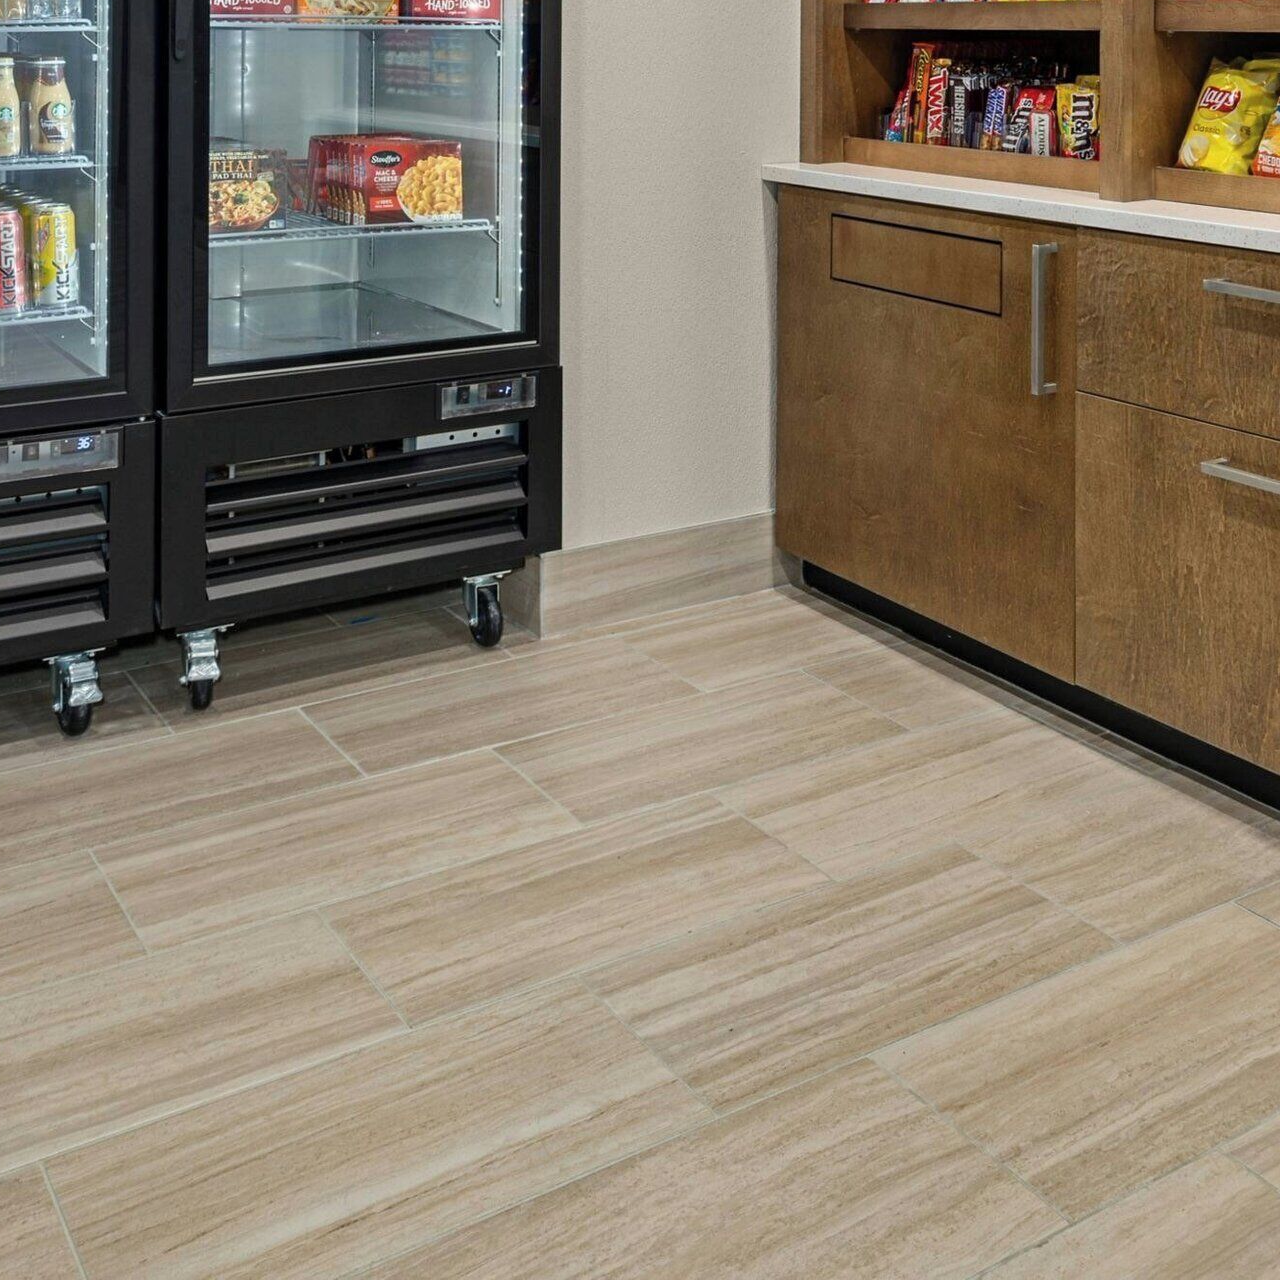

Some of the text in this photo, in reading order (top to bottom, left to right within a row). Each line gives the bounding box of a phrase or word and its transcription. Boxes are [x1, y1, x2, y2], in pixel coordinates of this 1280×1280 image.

[927, 69, 949, 133] TWIX
[983, 88, 997, 133] SNICKERS
[993, 86, 1006, 133] SNICKERS
[1199, 87, 1241, 112] Lay's
[1037, 116, 1045, 156] ALTOIDS
[1193, 123, 1221, 135] Classic
[210, 160, 254, 173] THAI
[0, 220, 17, 307] KICKSTART
